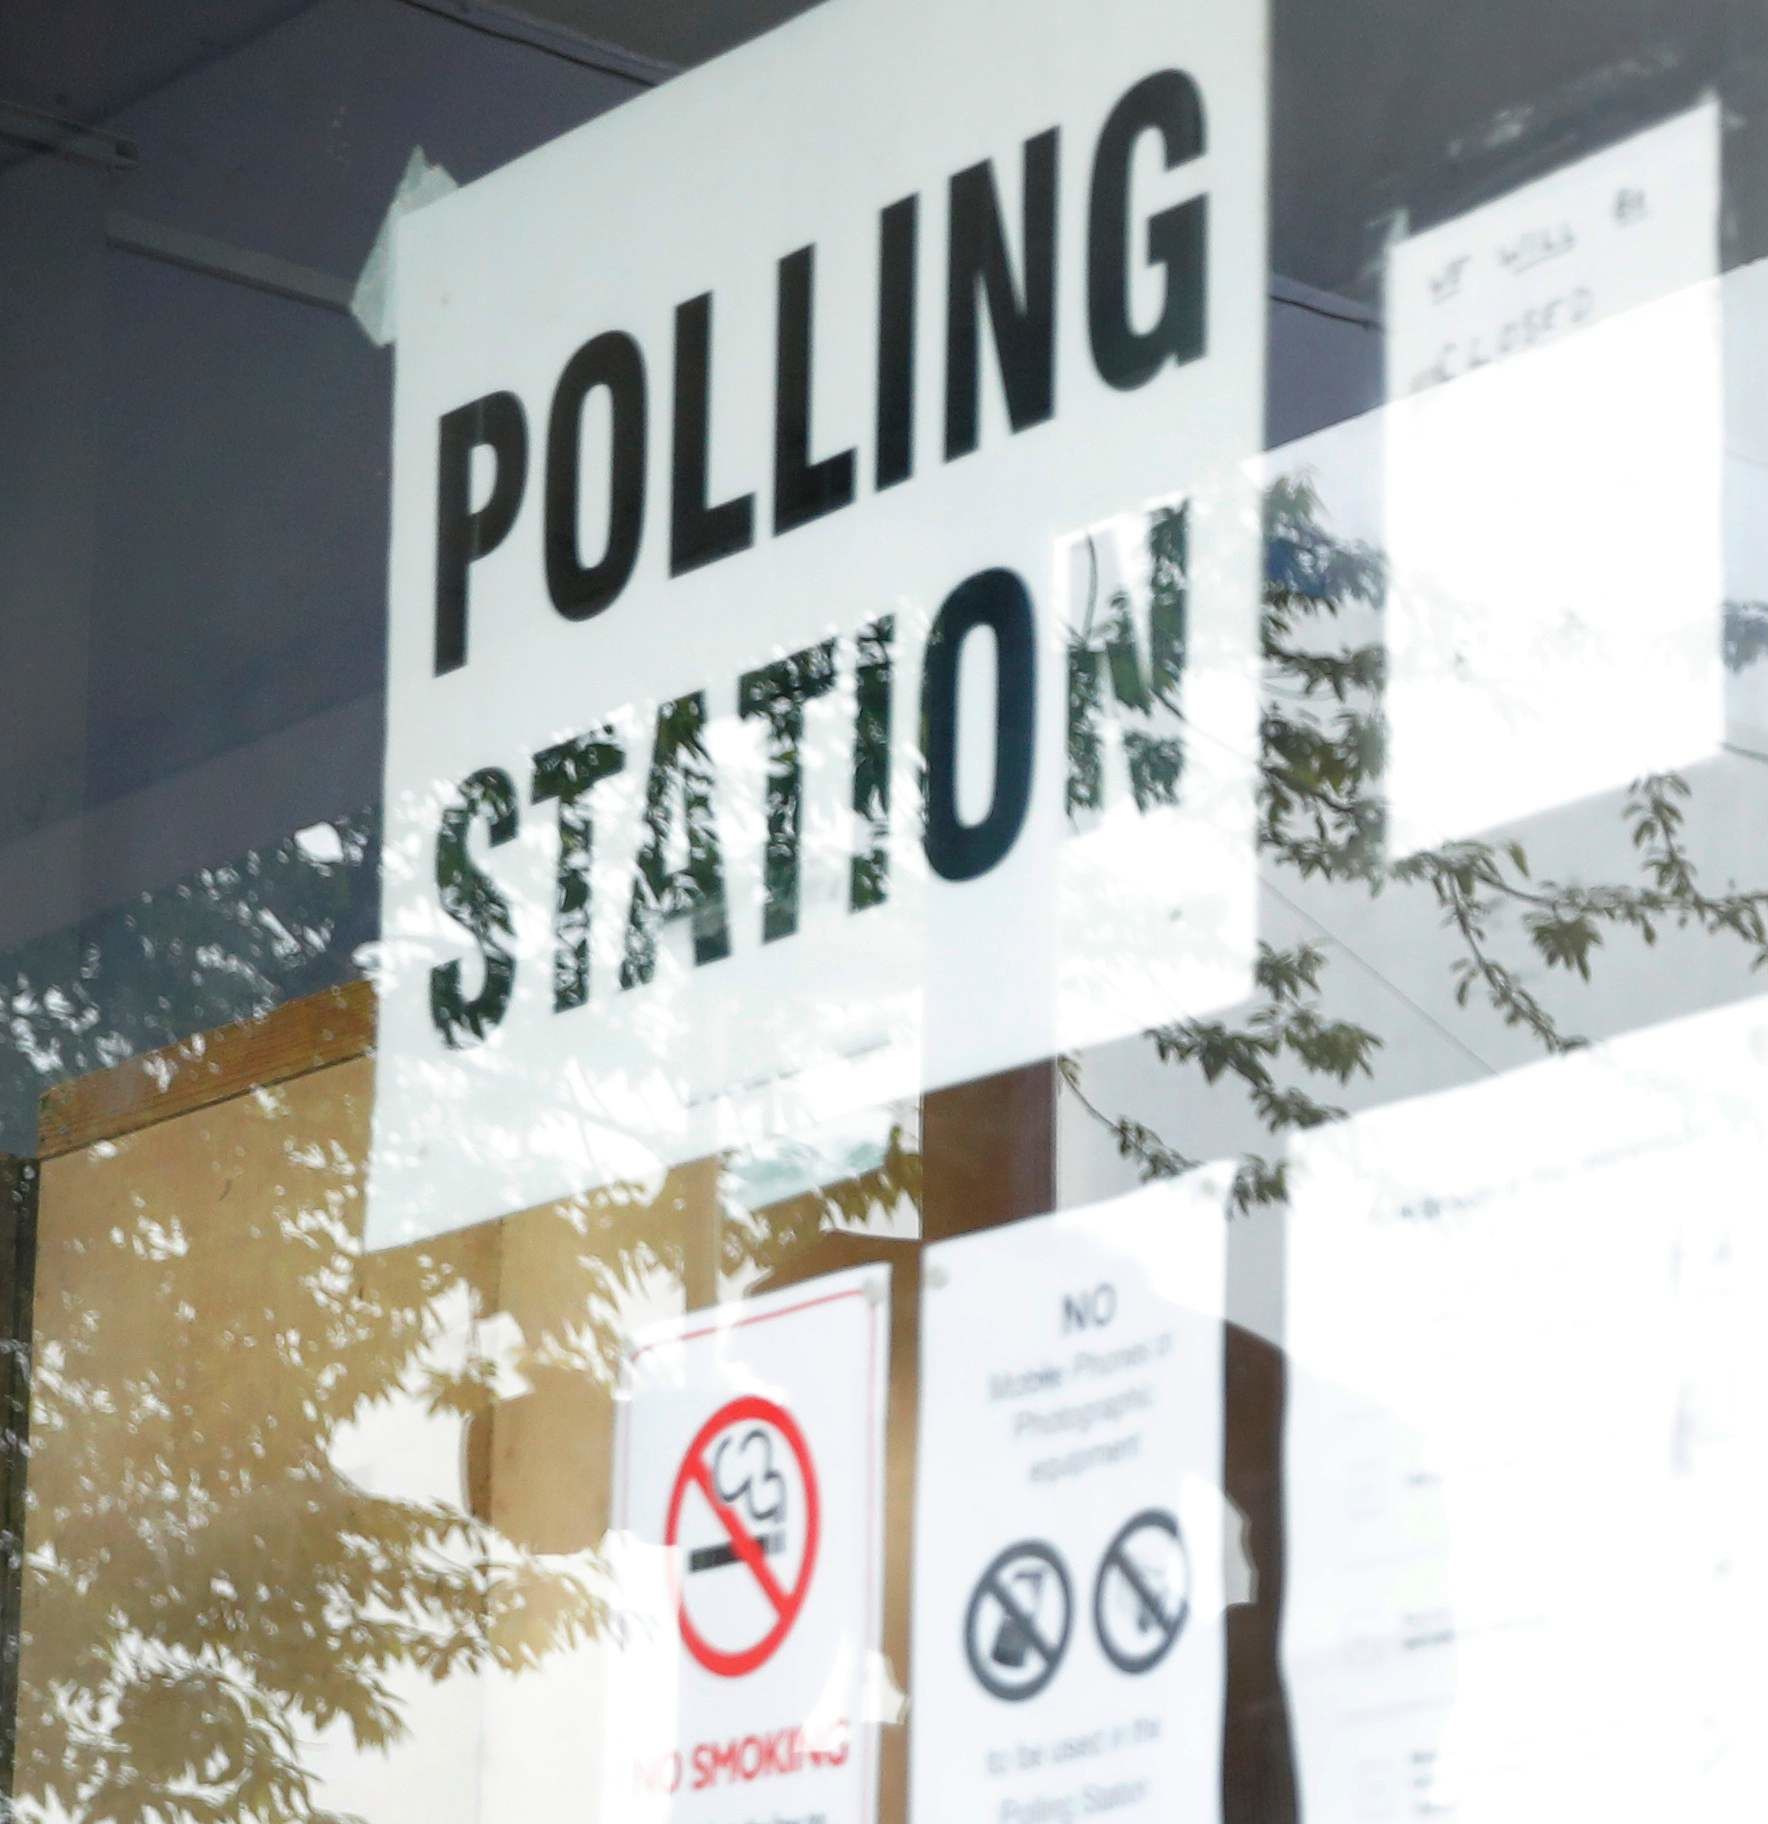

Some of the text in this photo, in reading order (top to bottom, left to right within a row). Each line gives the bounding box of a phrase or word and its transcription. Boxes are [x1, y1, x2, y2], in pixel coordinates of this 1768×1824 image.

[432, 66, 1211, 679] POLLING
[429, 496, 1193, 1050] STATION
[1060, 1282, 1119, 1337] NO
